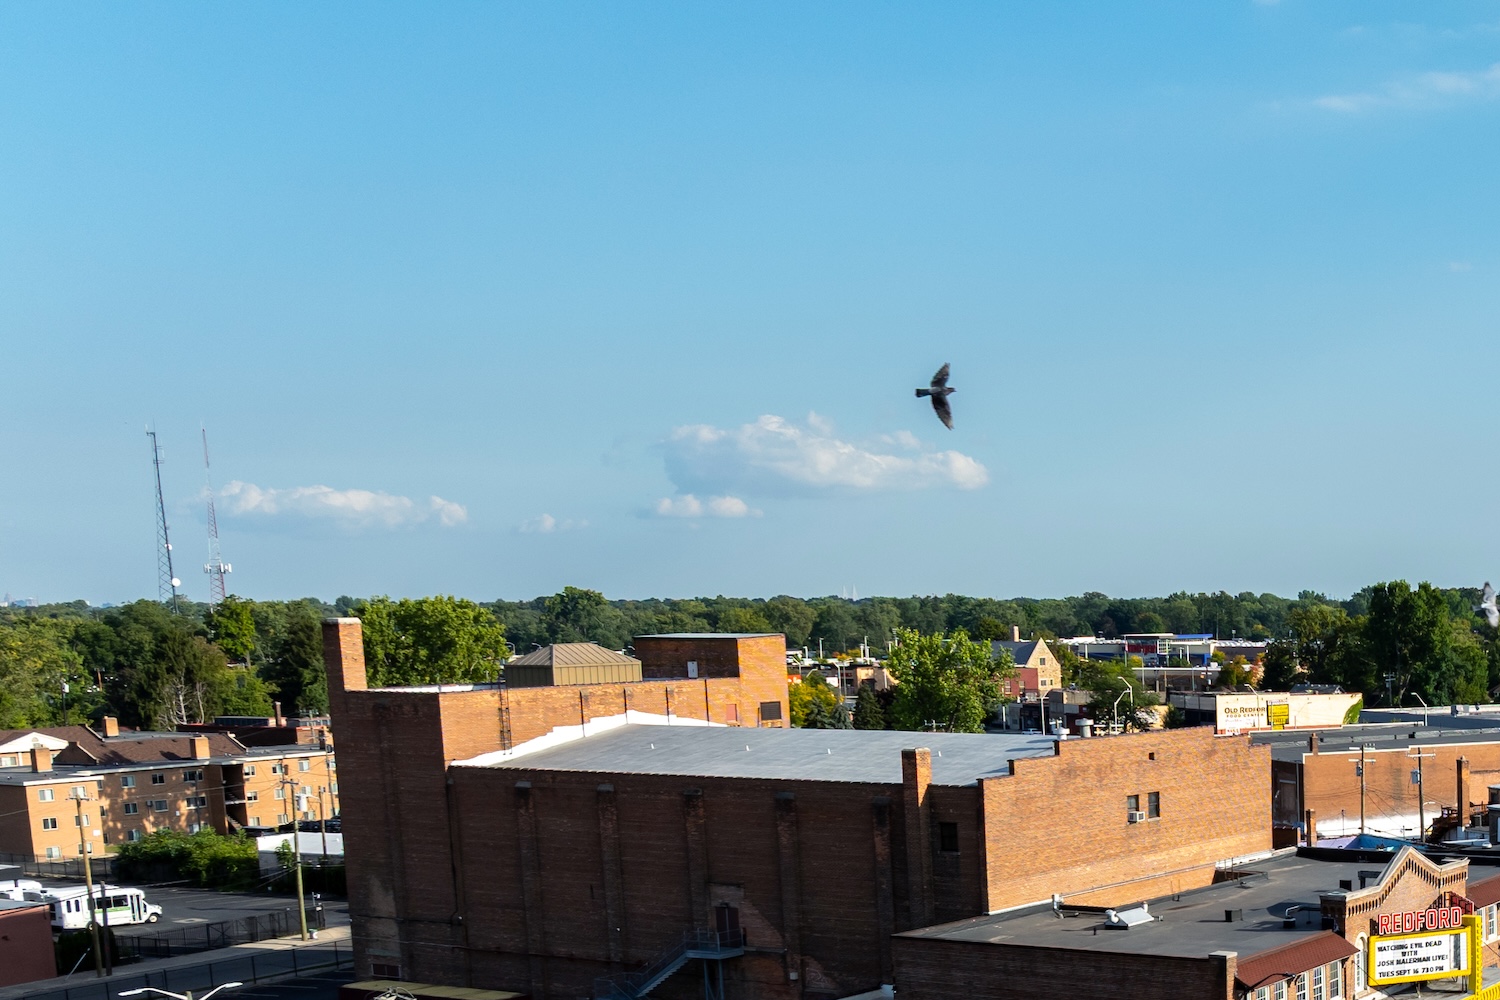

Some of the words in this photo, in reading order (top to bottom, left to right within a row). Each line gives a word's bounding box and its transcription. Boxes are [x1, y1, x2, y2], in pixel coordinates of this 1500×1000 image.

[1240, 706, 1266, 714] REDFOR
[1378, 906, 1462, 935] REDFORD
[1377, 943, 1409, 952] WATCHING
[1410, 942, 1423, 950] EVIL
[1425, 940, 1442, 948] DEAD
[1377, 959, 1395, 967] JOSH
[1396, 956, 1431, 965] MALERMAN
[1378, 970, 1394, 978] TUES
[1395, 968, 1410, 976] SEPT
